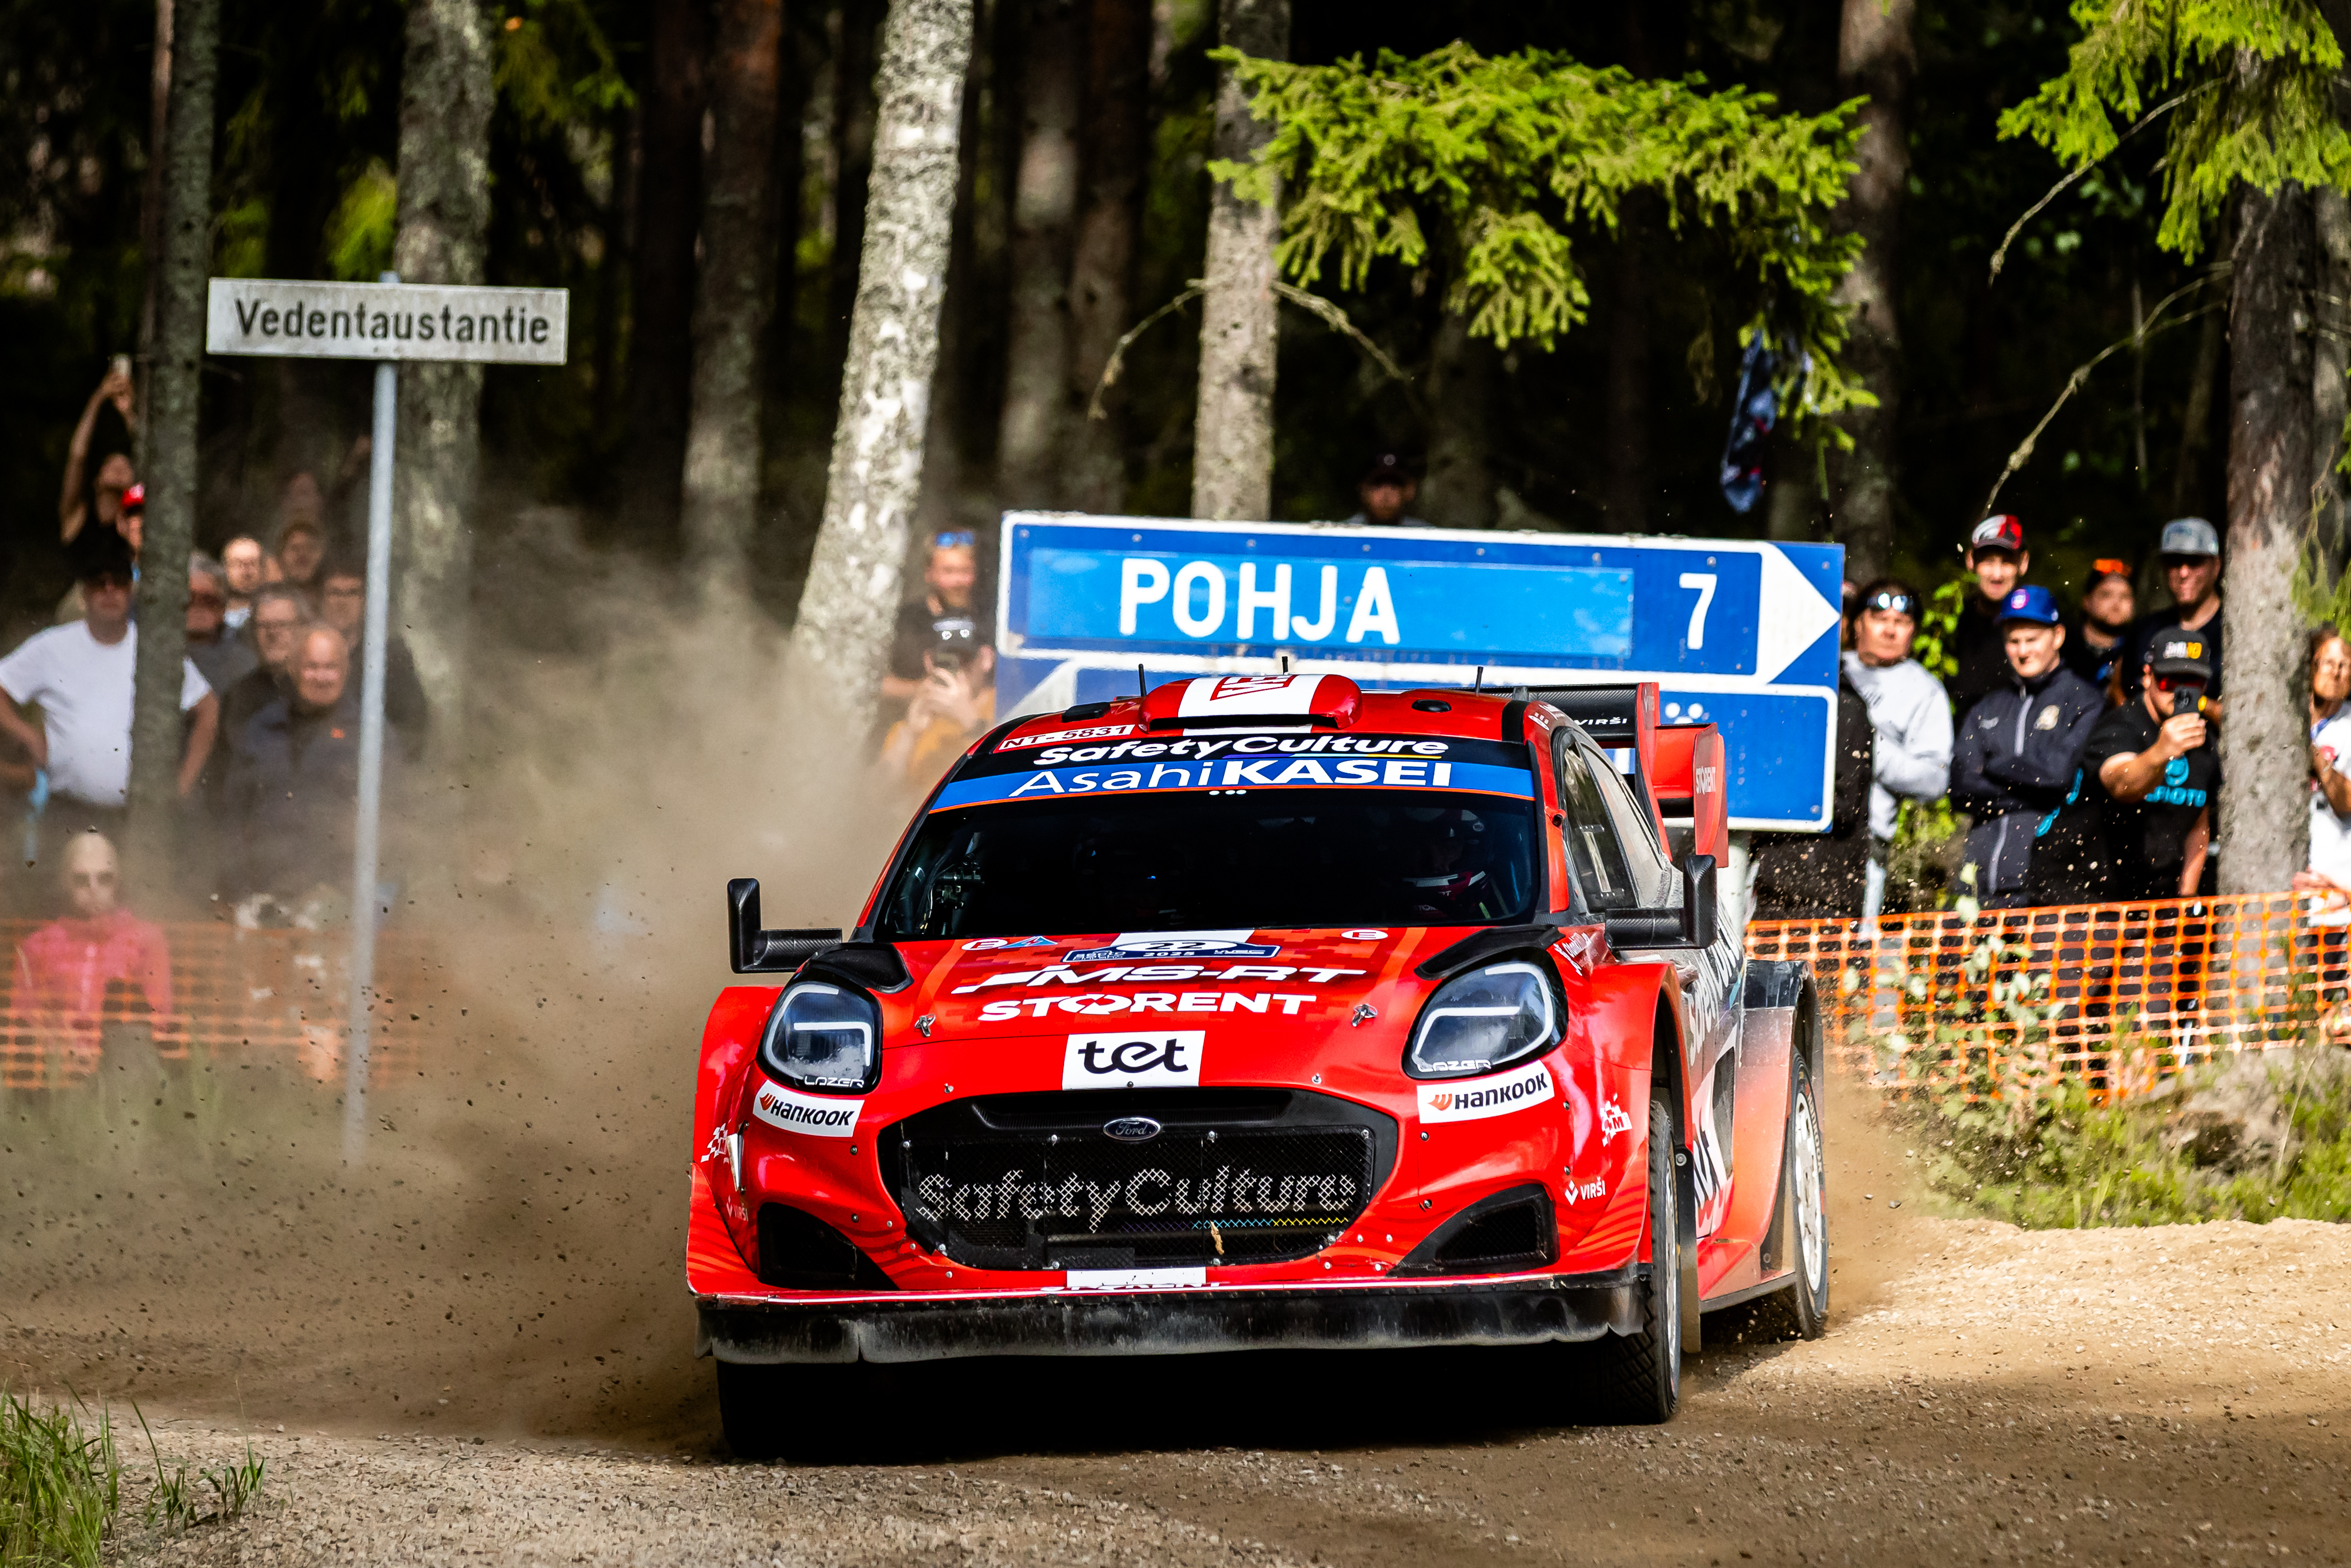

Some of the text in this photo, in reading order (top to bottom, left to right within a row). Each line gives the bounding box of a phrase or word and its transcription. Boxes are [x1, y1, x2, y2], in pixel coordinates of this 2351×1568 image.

[236, 299, 550, 344] Vedentaustantie
[1120, 558, 1717, 650] POHJA 7
[1033, 735, 1448, 765] SafetyCulture
[1009, 760, 1451, 797] Asahi KASEI
[978, 992, 1317, 1021] STORENT
[1077, 1038, 1188, 1074] tet
[1116, 1122, 1148, 1135] Ford
[916, 1165, 1356, 1233] SafetyCulture
[1580, 1176, 1606, 1200] VIRŠI
